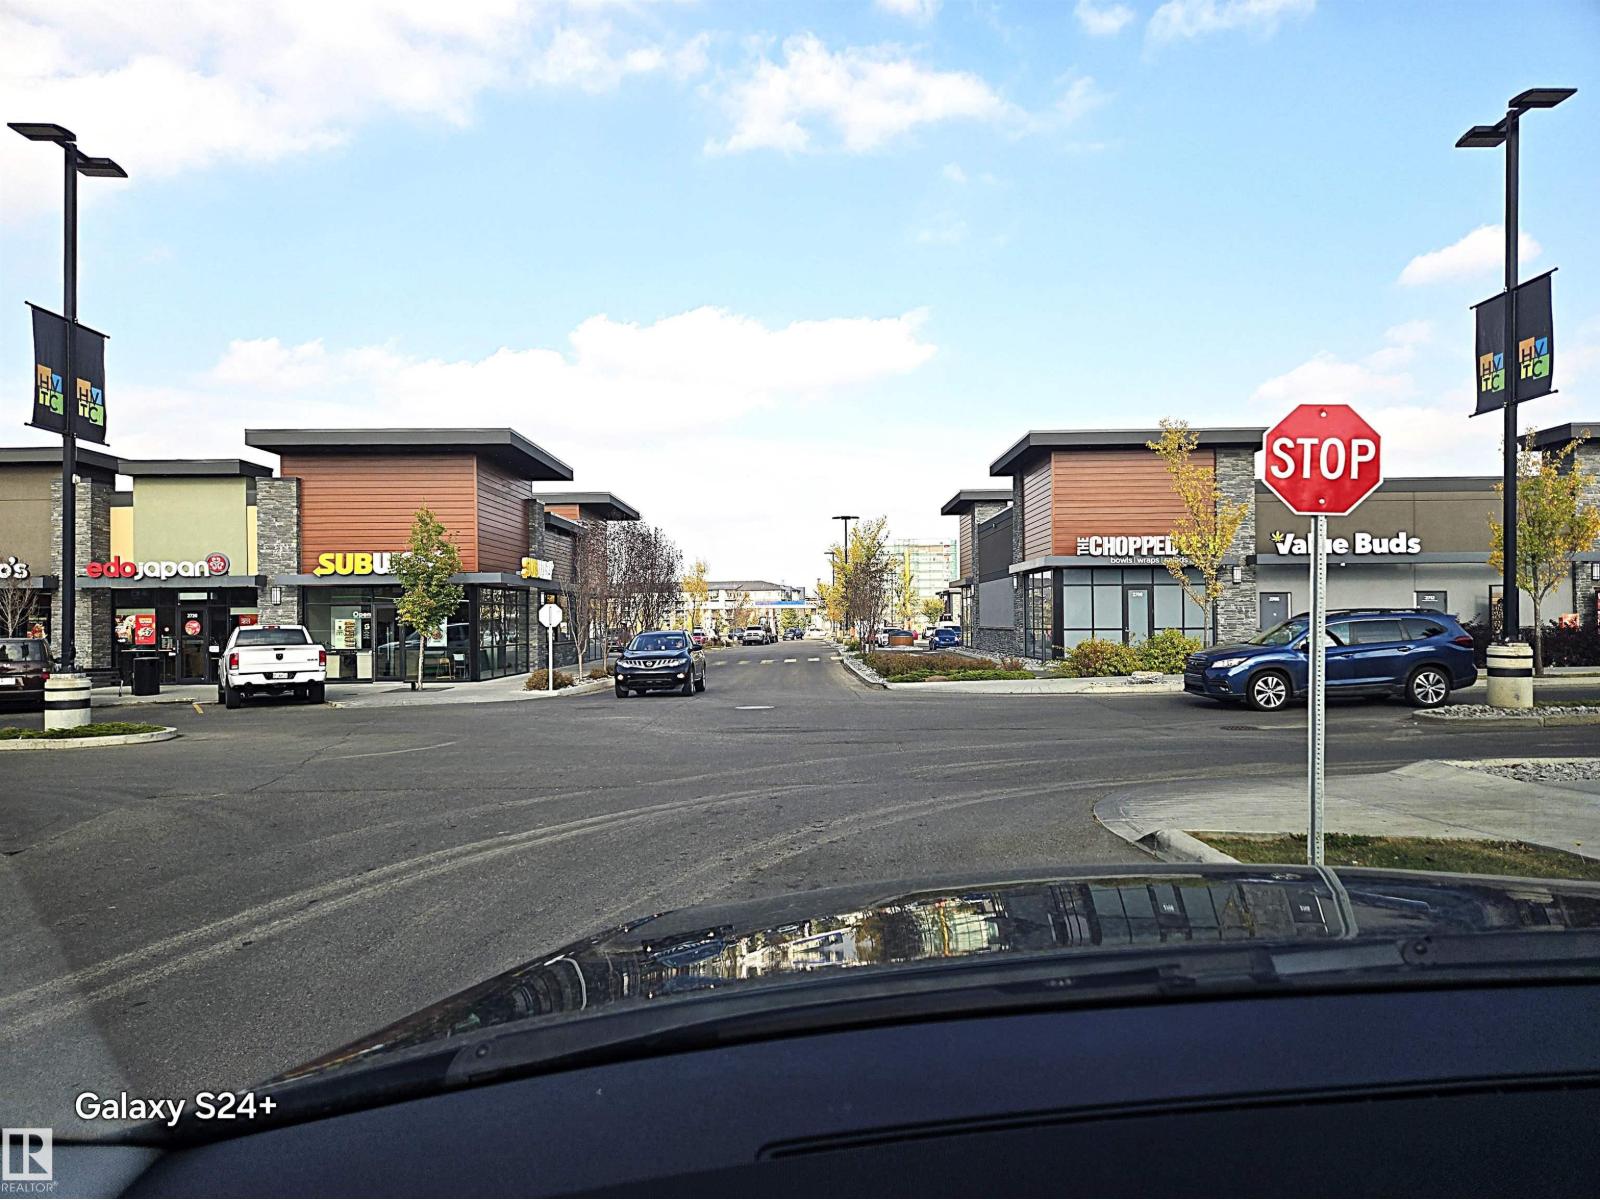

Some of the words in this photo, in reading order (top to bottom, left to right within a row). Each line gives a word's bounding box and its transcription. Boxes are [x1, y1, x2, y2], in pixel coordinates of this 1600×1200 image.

[1270, 437, 1376, 480] STOP
[1077, 536, 1090, 556] THE
[1354, 532, 1421, 554] Buds
[352, 611, 372, 619] Open
